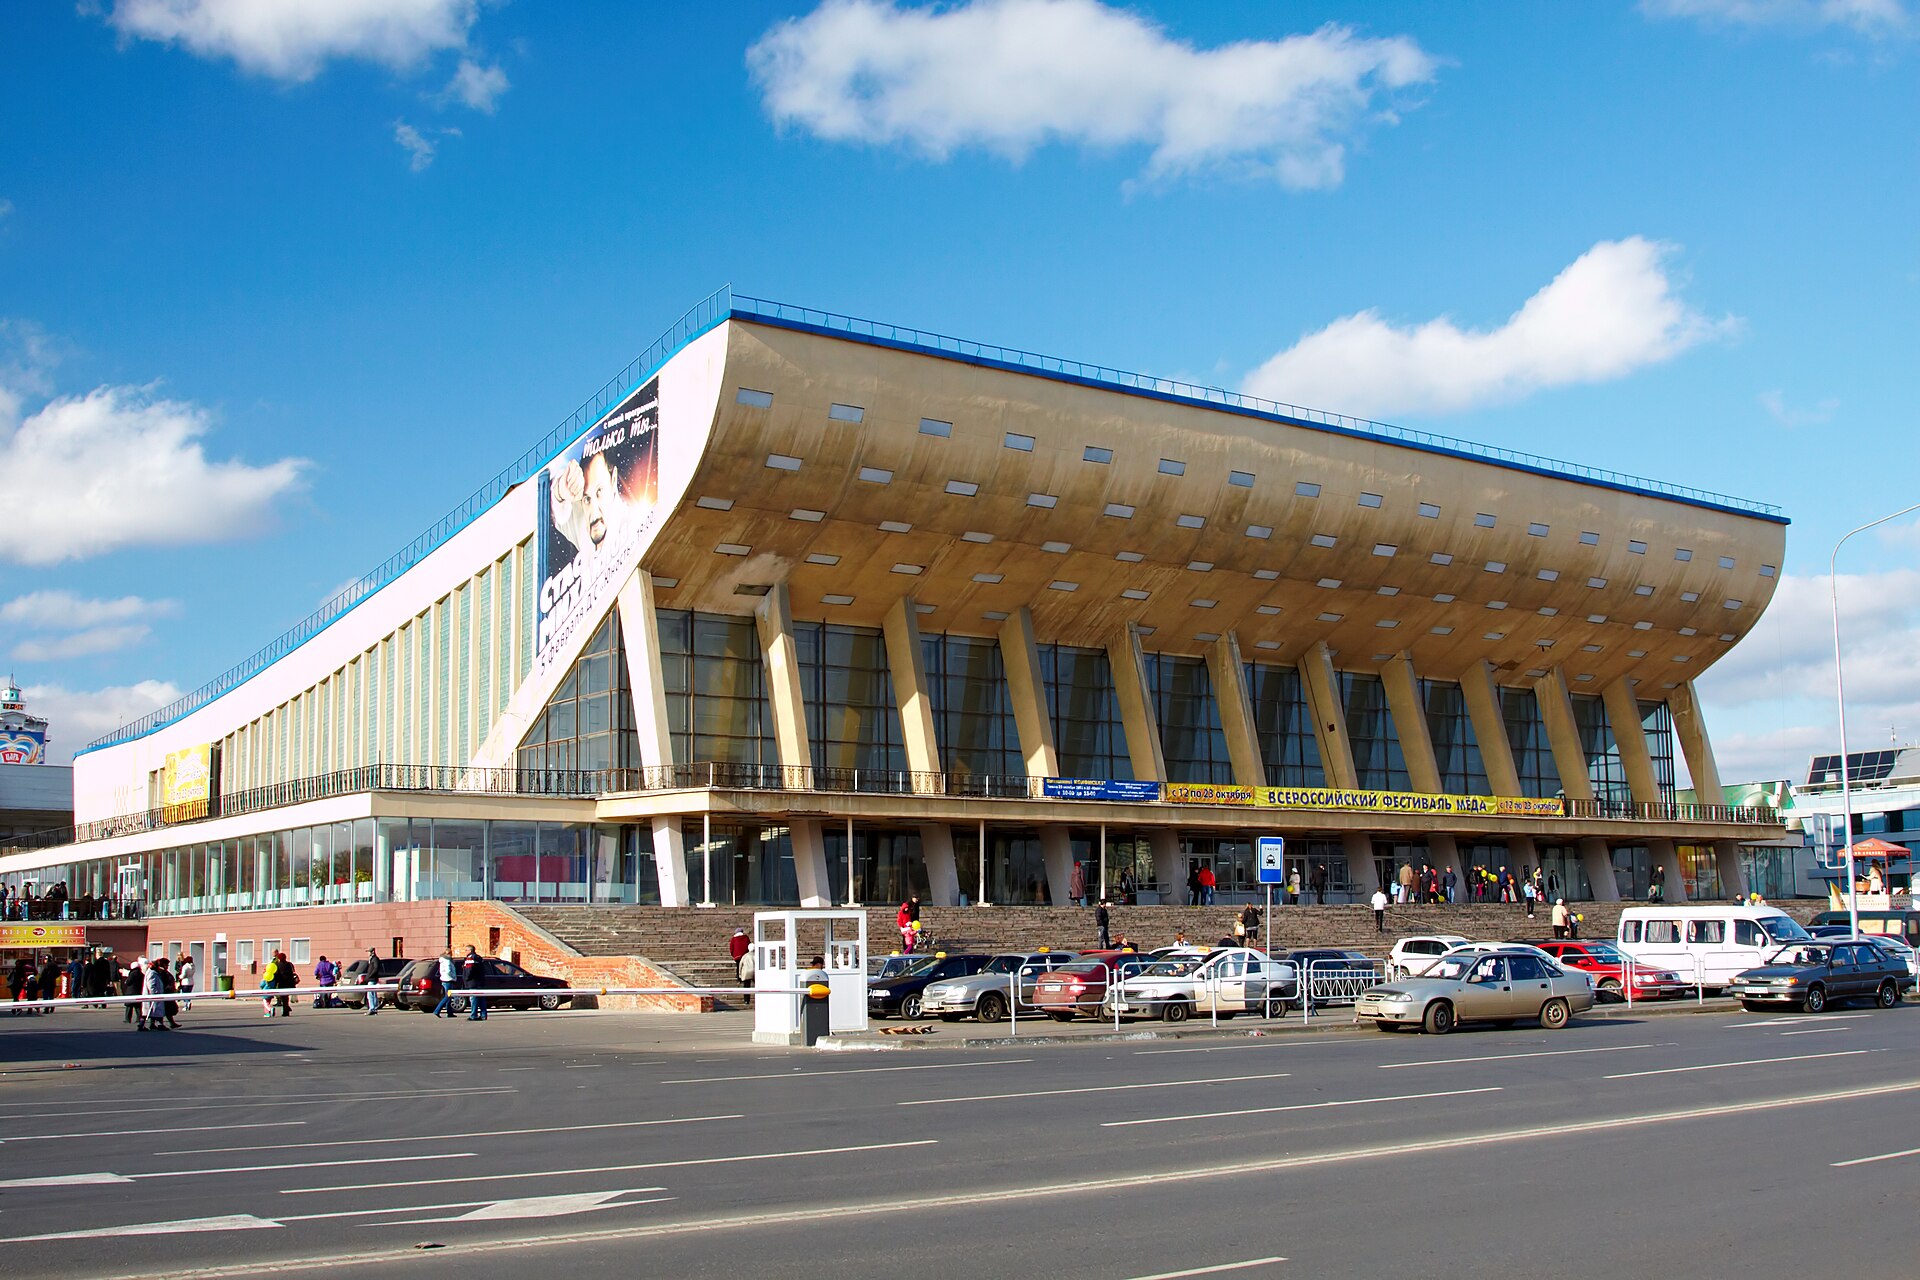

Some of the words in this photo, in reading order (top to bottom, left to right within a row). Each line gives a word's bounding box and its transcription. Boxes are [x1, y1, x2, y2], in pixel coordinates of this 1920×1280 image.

[540, 654, 546, 677] 5
[548, 606, 584, 667] февраля
[1172, 789, 1176, 797] с
[1178, 788, 1188, 797] 12
[1204, 788, 1214, 798] 23
[1216, 790, 1251, 800] октября
[1268, 790, 1377, 807] ВСЕРОССИЙСКИЙ
[1382, 794, 1452, 810] ФЕСТИВАЛЬ
[1456, 796, 1486, 812] МЁДА
[1524, 802, 1532, 810] 23
[1533, 802, 1560, 811] октября
